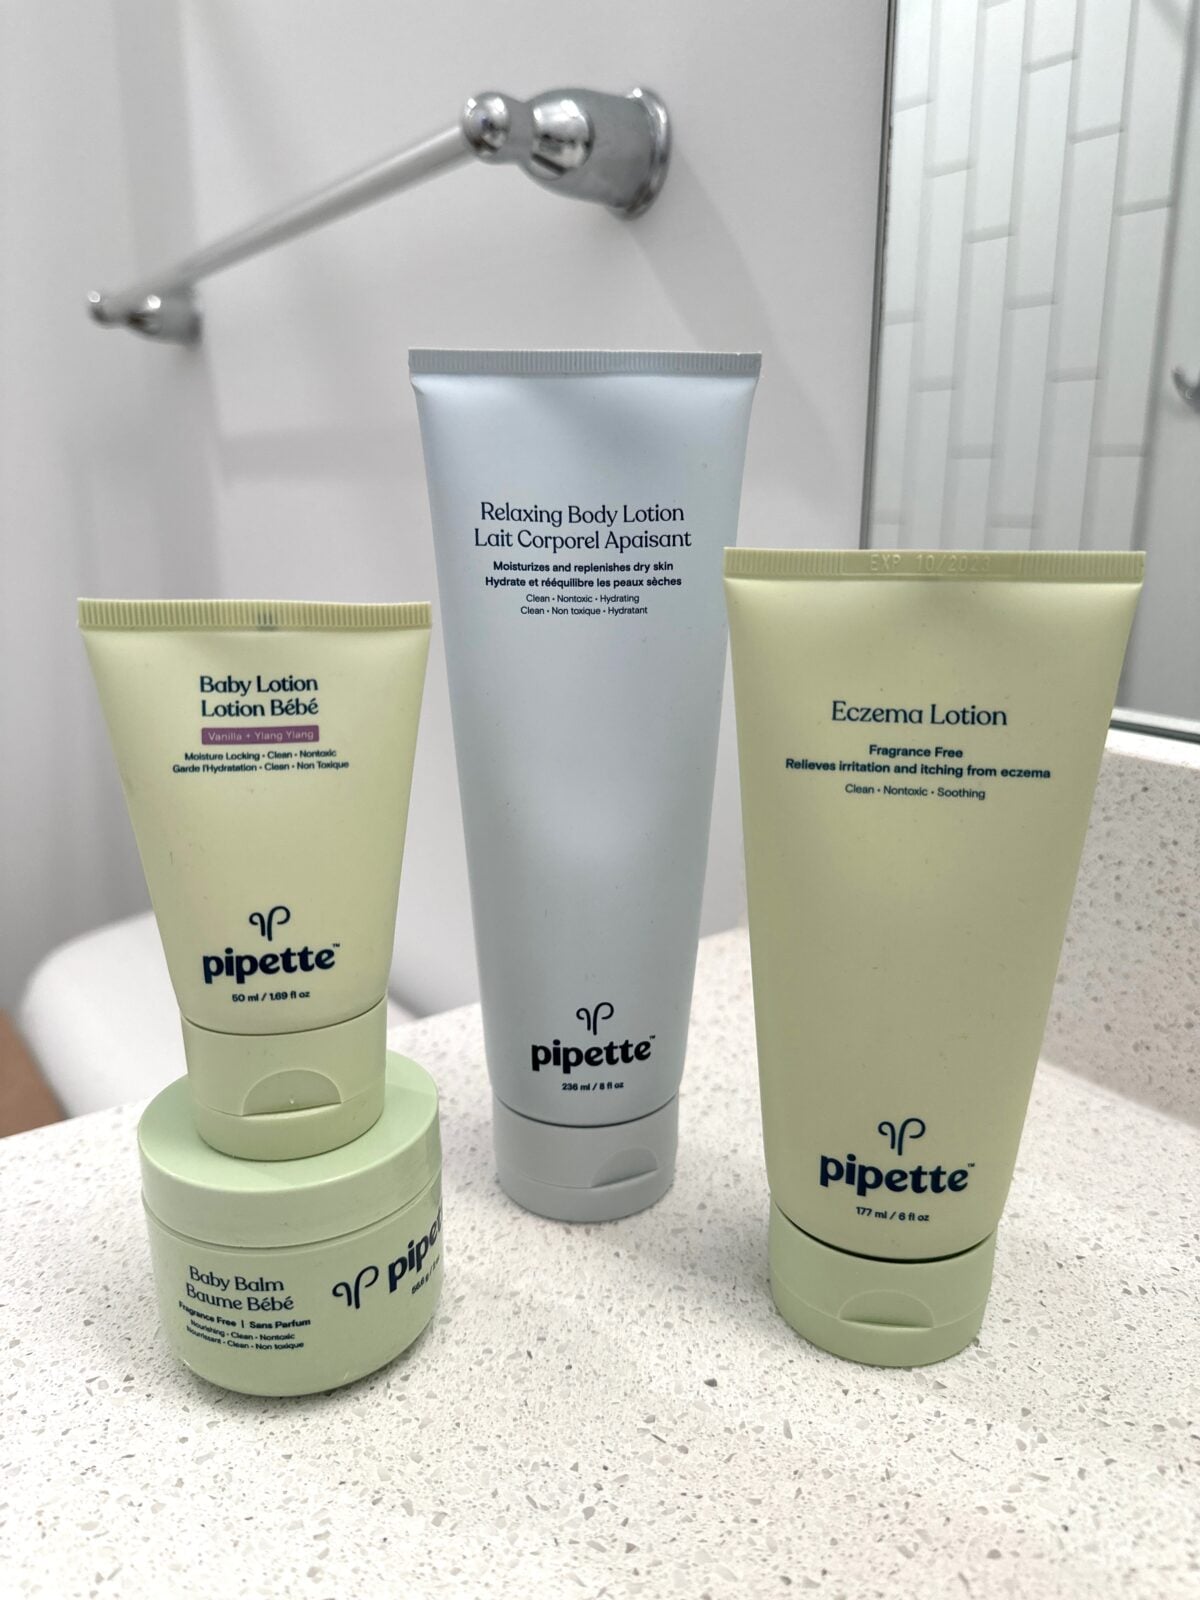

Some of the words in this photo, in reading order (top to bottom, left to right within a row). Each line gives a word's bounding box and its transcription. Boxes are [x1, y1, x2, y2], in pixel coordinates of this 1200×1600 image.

[481, 501, 562, 527] Relaxing
[568, 505, 618, 527] Body
[623, 505, 684, 522] Lotion
[475, 528, 513, 547] Lait
[518, 529, 599, 553] Corporel
[605, 531, 692, 553] Apaisant
[493, 561, 549, 572] Moisturizes
[553, 562, 571, 572] and
[574, 562, 630, 573] replenishes
[633, 562, 650, 573] dry
[653, 562, 673, 570] skin
[486, 577, 525, 588] Hydrate
[529, 578, 538, 587] et
[542, 577, 594, 589] rééquilibre
[597, 578, 610, 587] les
[613, 579, 644, 589] peaux
[647, 577, 682, 586] sèches
[526, 594, 550, 602] Clean
[600, 594, 639, 604] Hydrating
[571, 607, 600, 616] toxique
[608, 607, 647, 616] Hydratant
[200, 675, 251, 696] Baby
[256, 675, 318, 692] Lotion
[202, 700, 265, 717] Lotion
[271, 698, 318, 716] Bébé
[832, 700, 923, 724] Eczema
[930, 704, 1007, 725] Lotion
[208, 732, 242, 741] Vanilla
[255, 732, 283, 741] Ylang
[286, 730, 314, 740] Ylang
[185, 752, 223, 761] Moisture
[226, 752, 260, 761] Locking
[267, 751, 292, 759] Clean
[300, 749, 336, 757] Nontoxic
[869, 745, 931, 758] Fragrance
[935, 747, 963, 758] Free
[173, 764, 200, 773] Garde
[317, 761, 349, 770] Toxique
[785, 759, 835, 771] Relieves
[839, 761, 890, 773] irritation
[894, 764, 917, 774] and
[920, 764, 963, 777] itching
[967, 765, 996, 777] from
[1001, 768, 1051, 778] eczema
[845, 784, 874, 794] Clean
[884, 786, 927, 796] Nontoxic
[937, 787, 985, 800] Soothing
[203, 946, 335, 984] pipette
[232, 994, 245, 1002] 50
[290, 991, 296, 999] fl
[532, 1039, 651, 1074] pipette
[562, 1083, 578, 1091] 236
[820, 1154, 968, 1197] pipette
[856, 1207, 872, 1216] 177
[875, 1210, 887, 1219] ml
[908, 1213, 915, 1221] fl
[189, 1265, 230, 1291] Baby
[235, 1276, 284, 1291] Balm
[186, 1283, 242, 1310] Baume
[247, 1296, 294, 1311] Bébé
[179, 1301, 214, 1322] Fragrance
[217, 1317, 236, 1326] Free
[250, 1321, 273, 1329] Sans
[275, 1319, 310, 1328] Parfum
[231, 1332, 253, 1340] Clean
